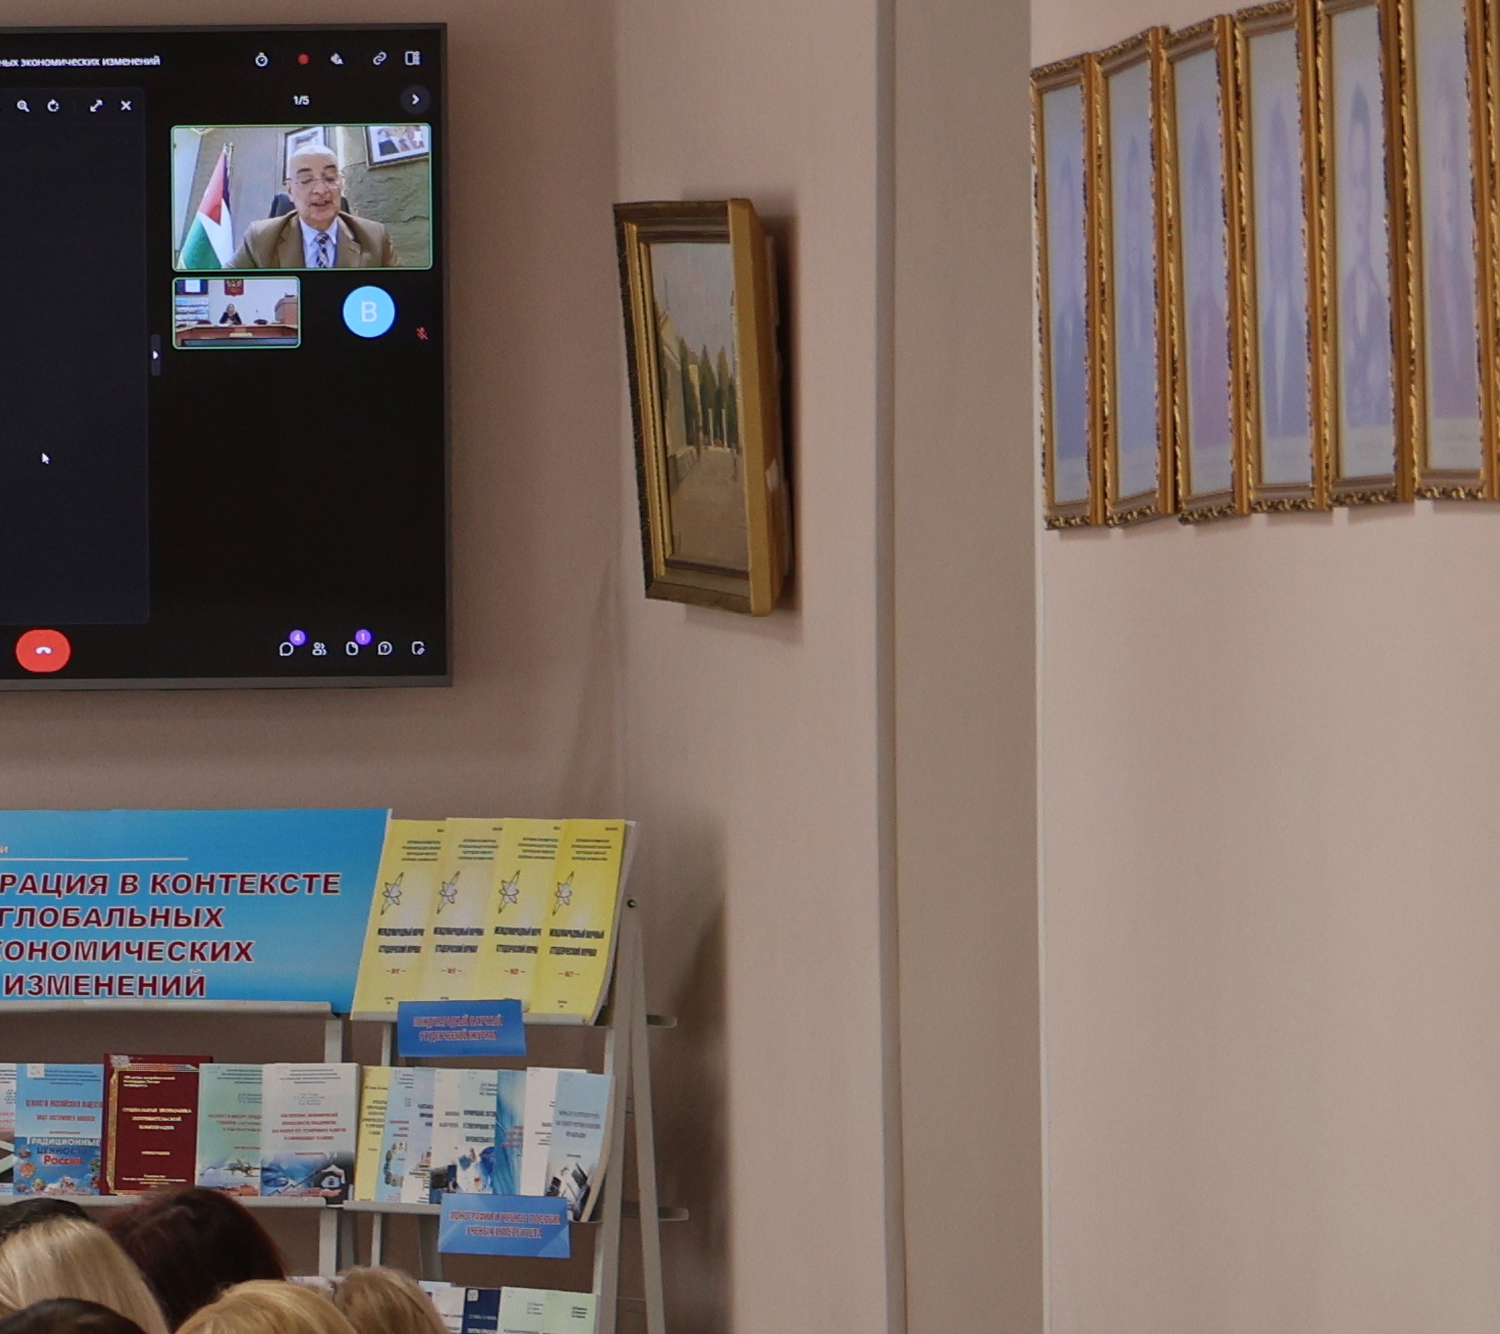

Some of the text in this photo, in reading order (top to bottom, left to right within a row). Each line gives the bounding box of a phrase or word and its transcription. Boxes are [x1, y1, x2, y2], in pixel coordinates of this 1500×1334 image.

[21, 58, 100, 68] экономических
[102, 56, 160, 67] изменений
[293, 95, 310, 106] 1/5
[294, 633, 301, 642] 4
[120, 873, 140, 895] В
[151, 873, 342, 895] КОНТЕКСТЕ
[2, 969, 206, 997] ИЗМЕНЕНИЙ
